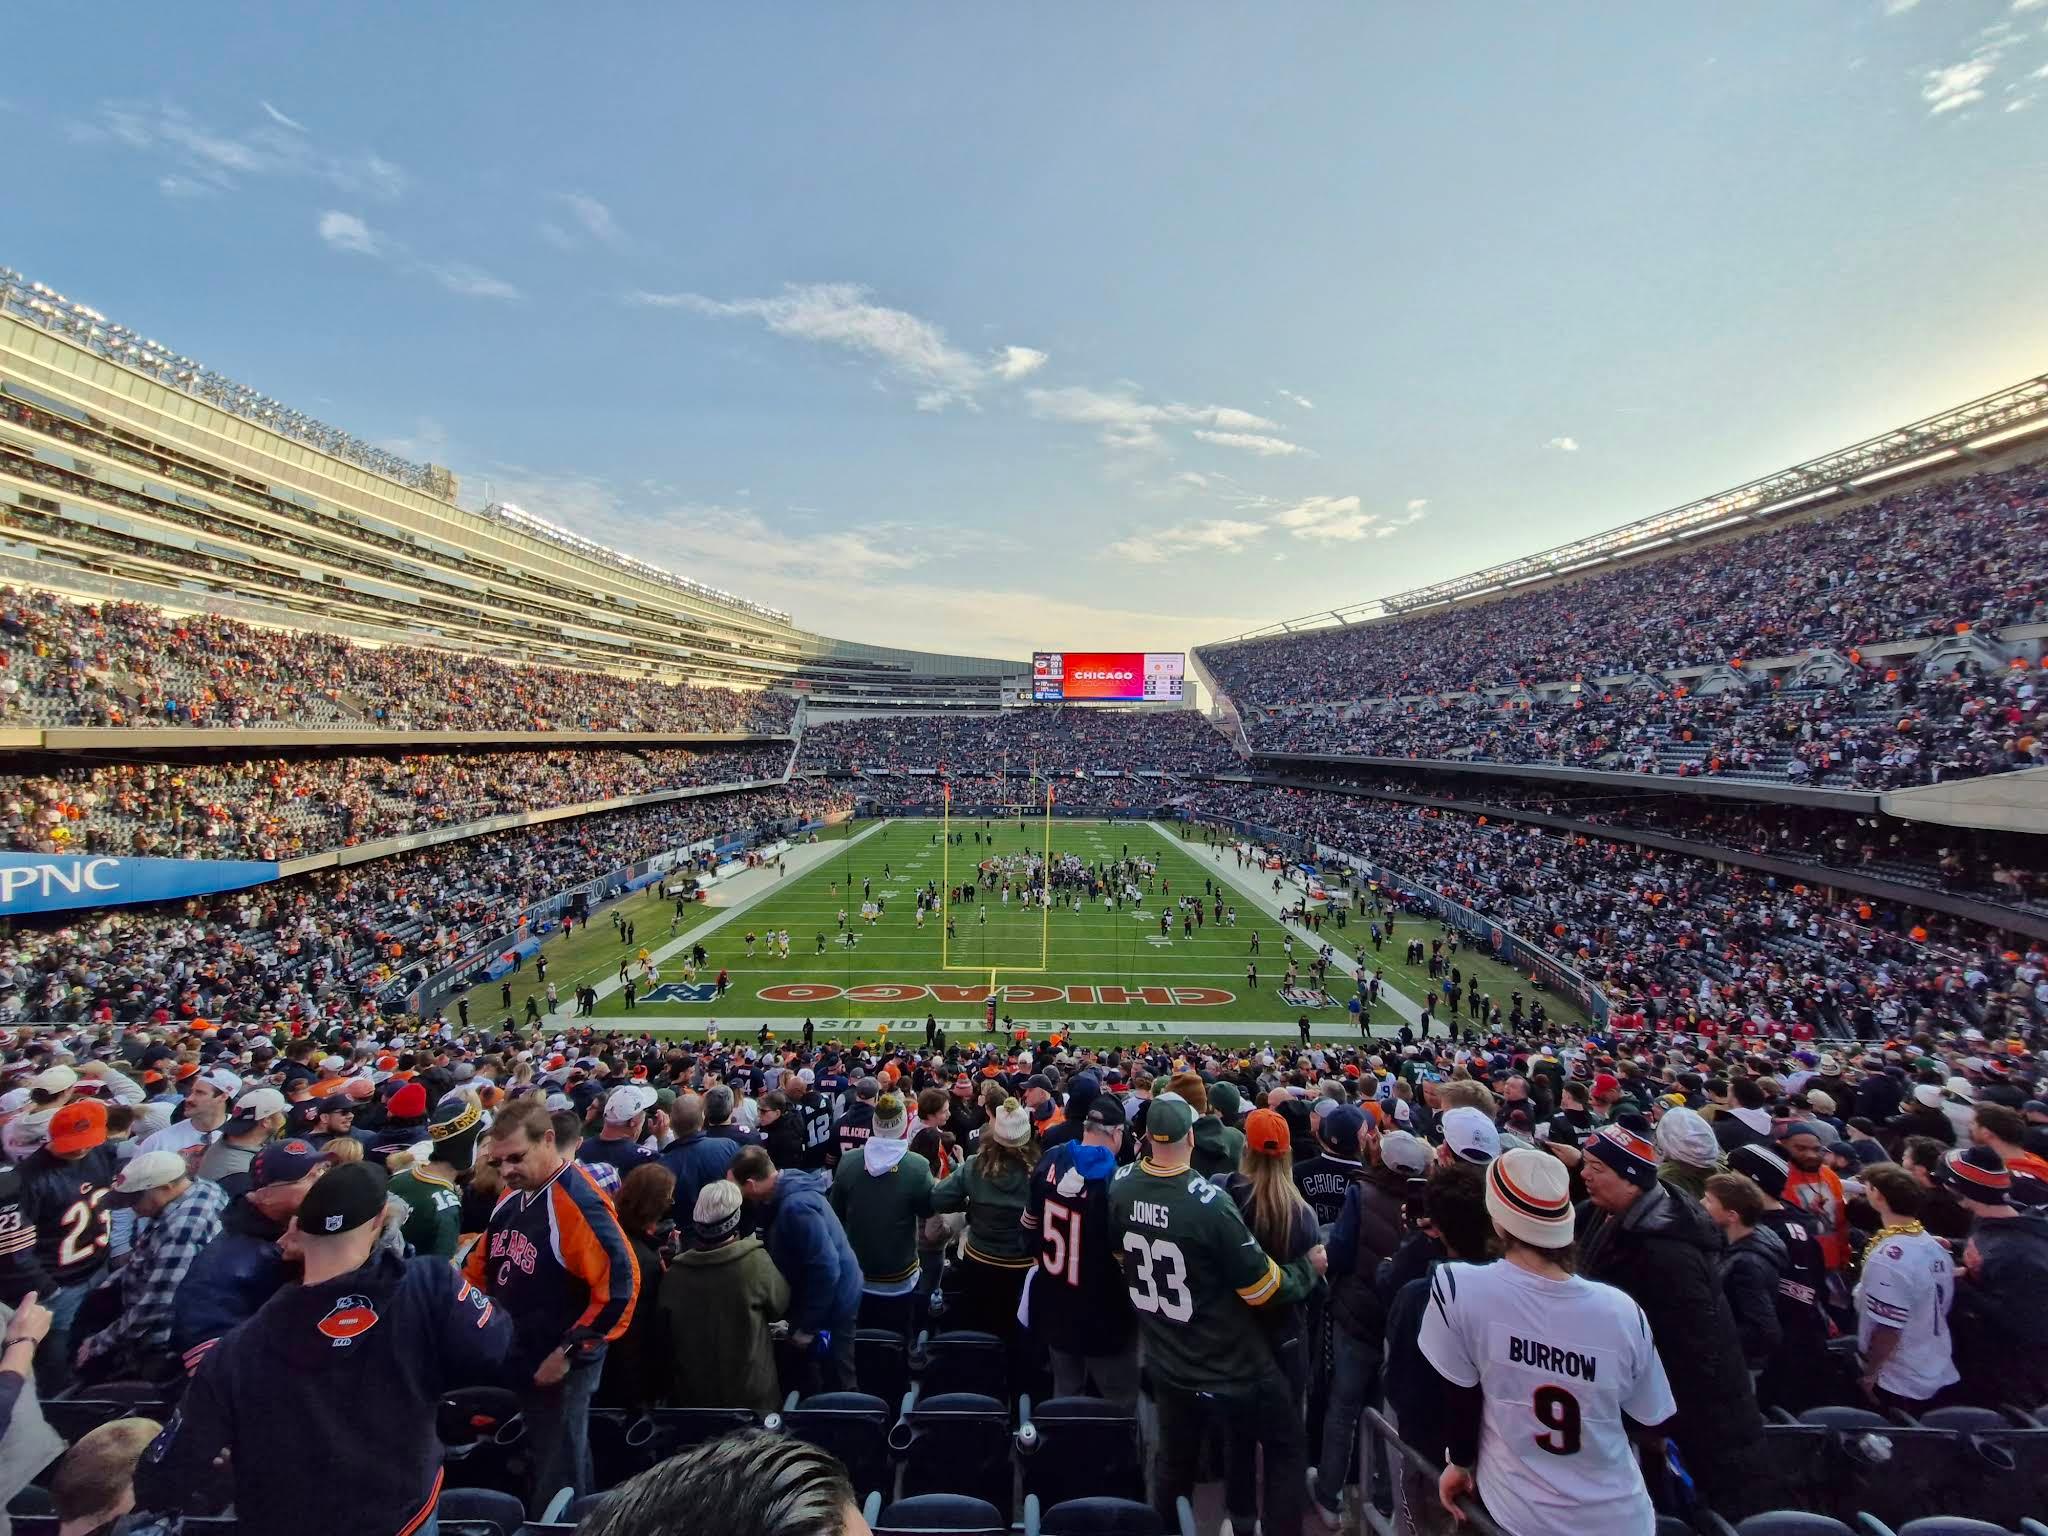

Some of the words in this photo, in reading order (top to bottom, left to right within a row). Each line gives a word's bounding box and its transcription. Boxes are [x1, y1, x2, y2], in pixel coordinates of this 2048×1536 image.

[1074, 671, 1133, 680] CHICAGO
[0, 858, 121, 903] PNC
[756, 984, 1237, 1006] CHICAGO
[819, 1019, 861, 1029] US
[1013, 1020, 1120, 1032] TAKES
[1137, 1022, 1167, 1032] IT
[806, 1113, 831, 1148] 12
[1302, 1173, 1350, 1196] CHIC
[431, 1189, 462, 1211] 12
[0, 1210, 22, 1233] 23
[1129, 1200, 1169, 1229] JONES
[1042, 1199, 1081, 1286] 51
[1122, 1231, 1194, 1323] 33
[1509, 1335, 1597, 1382] BURROW
[1533, 1383, 1582, 1456] 9
